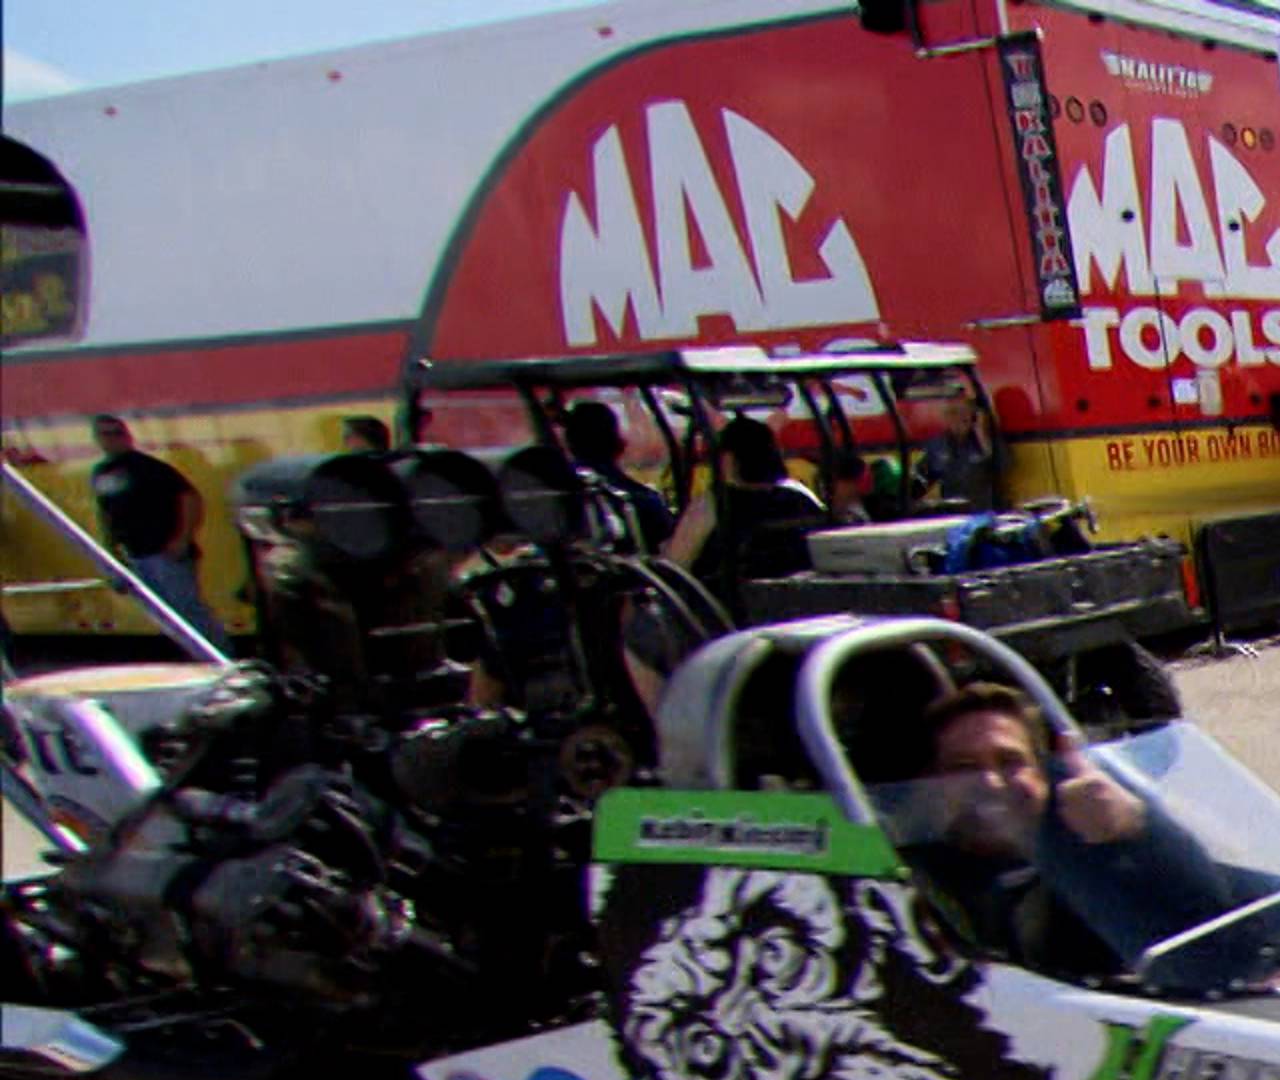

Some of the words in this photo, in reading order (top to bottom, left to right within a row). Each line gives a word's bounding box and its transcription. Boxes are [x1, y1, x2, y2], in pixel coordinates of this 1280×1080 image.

[559, 99, 881, 347] MAC
[1107, 440, 1135, 471] BE
[1143, 434, 1200, 469] YOUR
[1207, 430, 1252, 464] OWN
